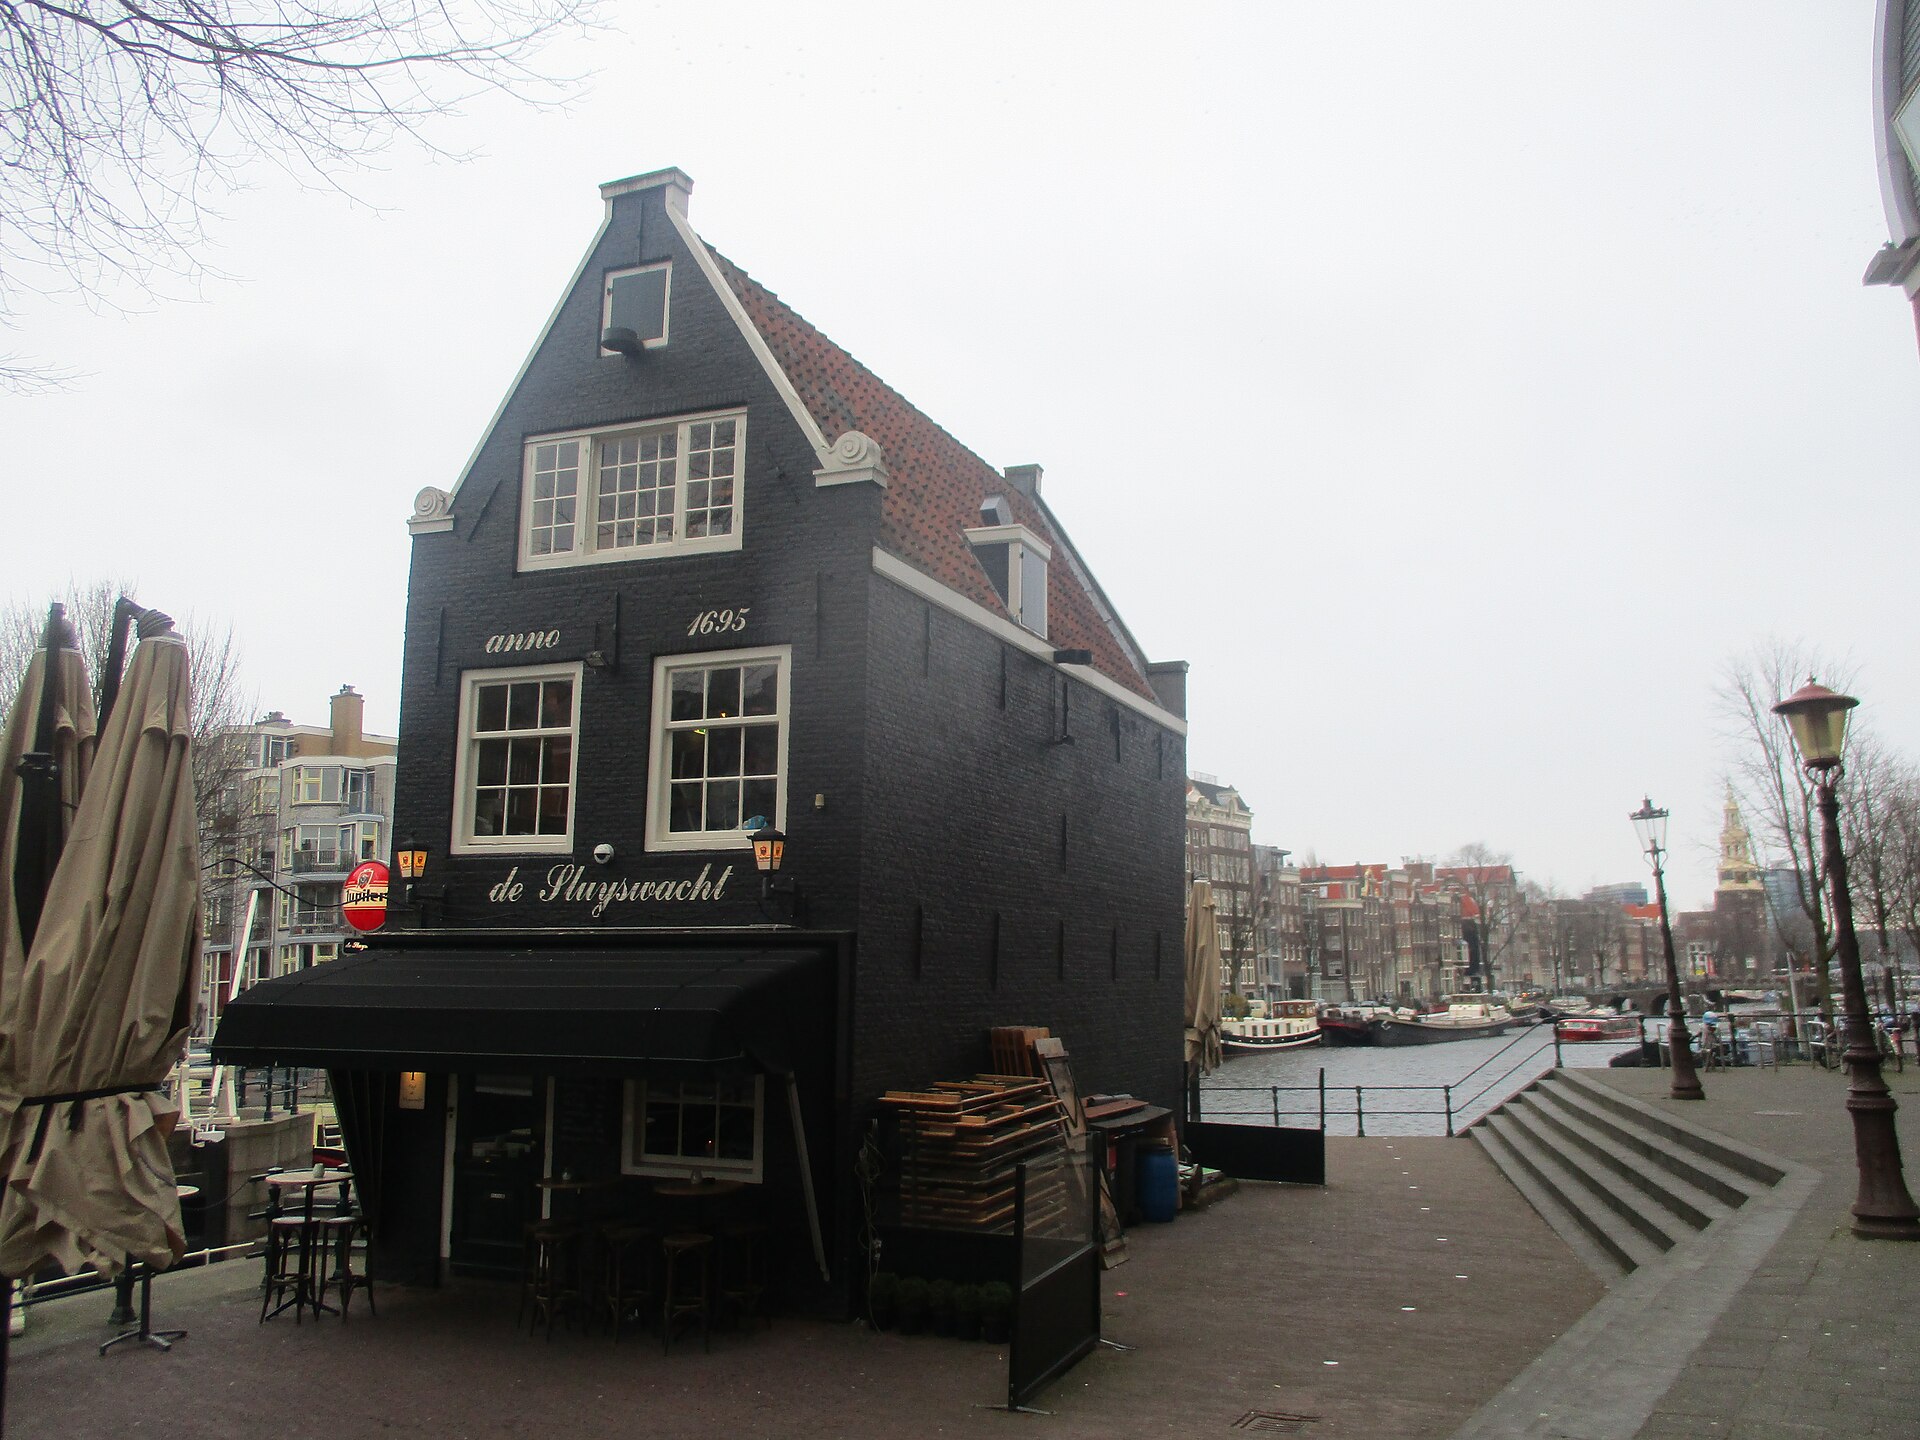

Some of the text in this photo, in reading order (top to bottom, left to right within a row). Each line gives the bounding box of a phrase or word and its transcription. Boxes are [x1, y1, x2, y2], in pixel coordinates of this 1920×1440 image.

[485, 608, 750, 654] anno 1695
[489, 863, 734, 918] de Sluyswacht
